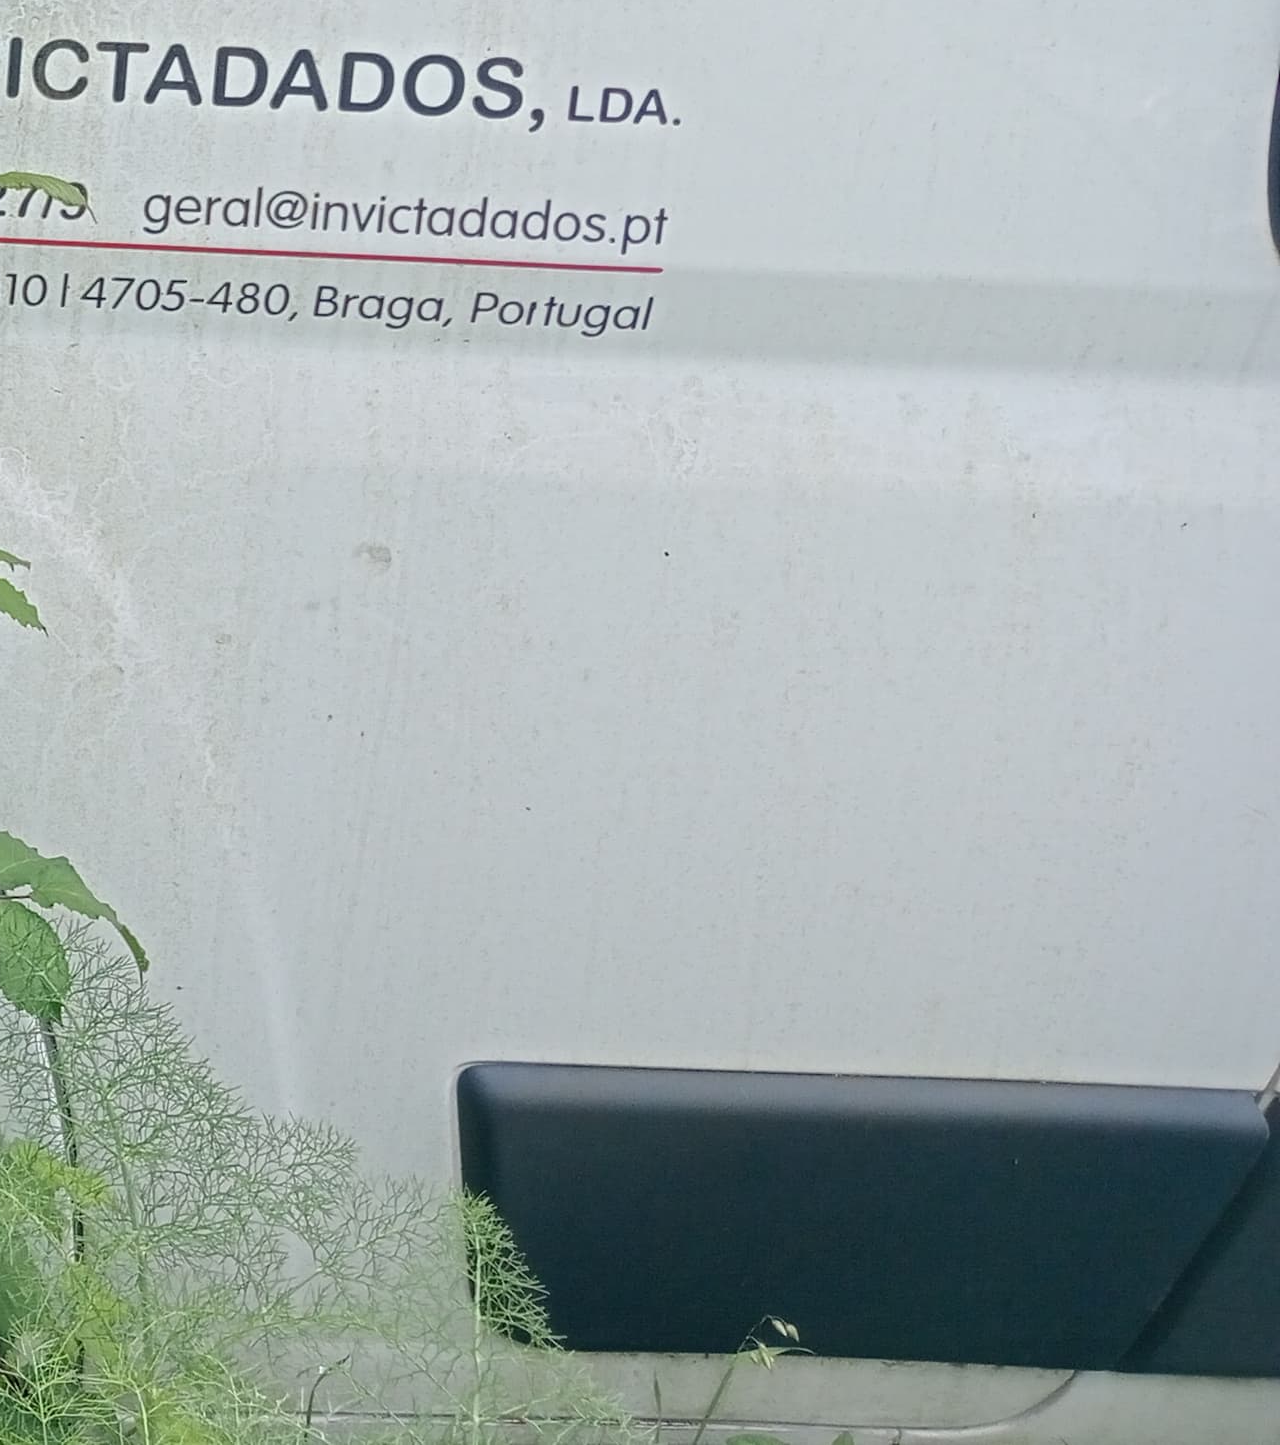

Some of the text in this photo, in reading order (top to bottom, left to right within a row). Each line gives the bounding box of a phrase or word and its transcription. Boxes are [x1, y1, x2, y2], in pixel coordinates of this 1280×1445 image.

[567, 84, 683, 127] LDA.
[142, 186, 669, 254] geral@invictadados.pt
[79, 276, 300, 324] 4705-480,
[312, 284, 453, 331] Braga,
[469, 291, 655, 338] Portugal
